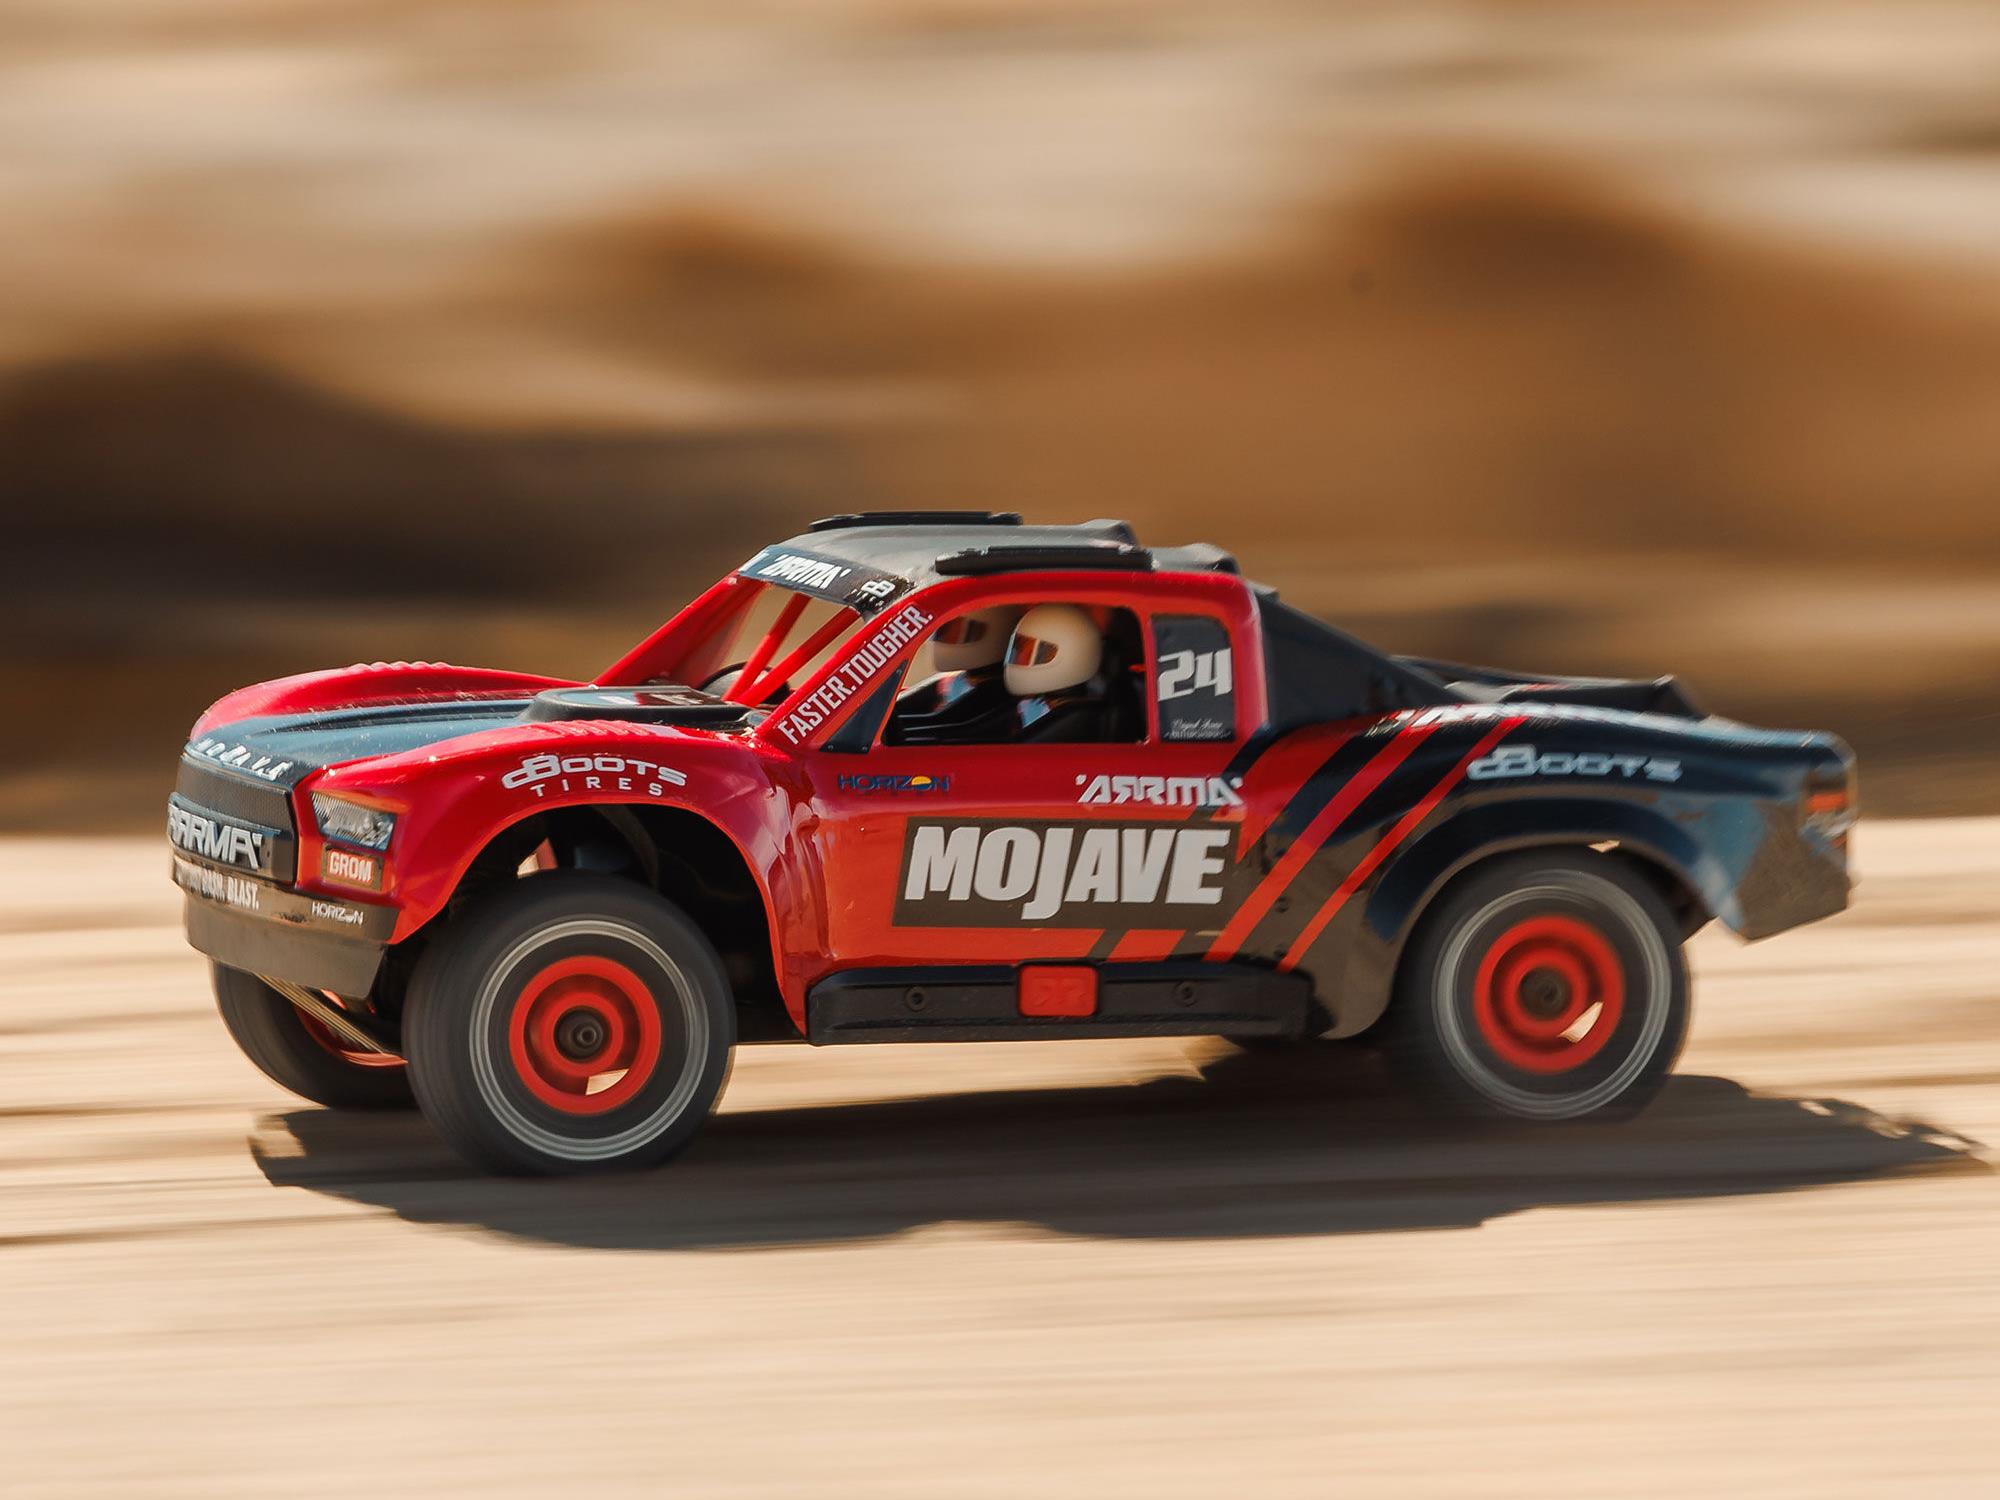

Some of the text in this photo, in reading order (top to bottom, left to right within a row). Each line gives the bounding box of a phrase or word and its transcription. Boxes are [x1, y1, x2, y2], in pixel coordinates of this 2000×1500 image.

[1157, 648, 1233, 702] 24
[530, 776, 664, 798] TIRES
[837, 774, 951, 793] HORIZON
[328, 850, 373, 883] GROM
[904, 825, 1231, 921] MOJAVE
